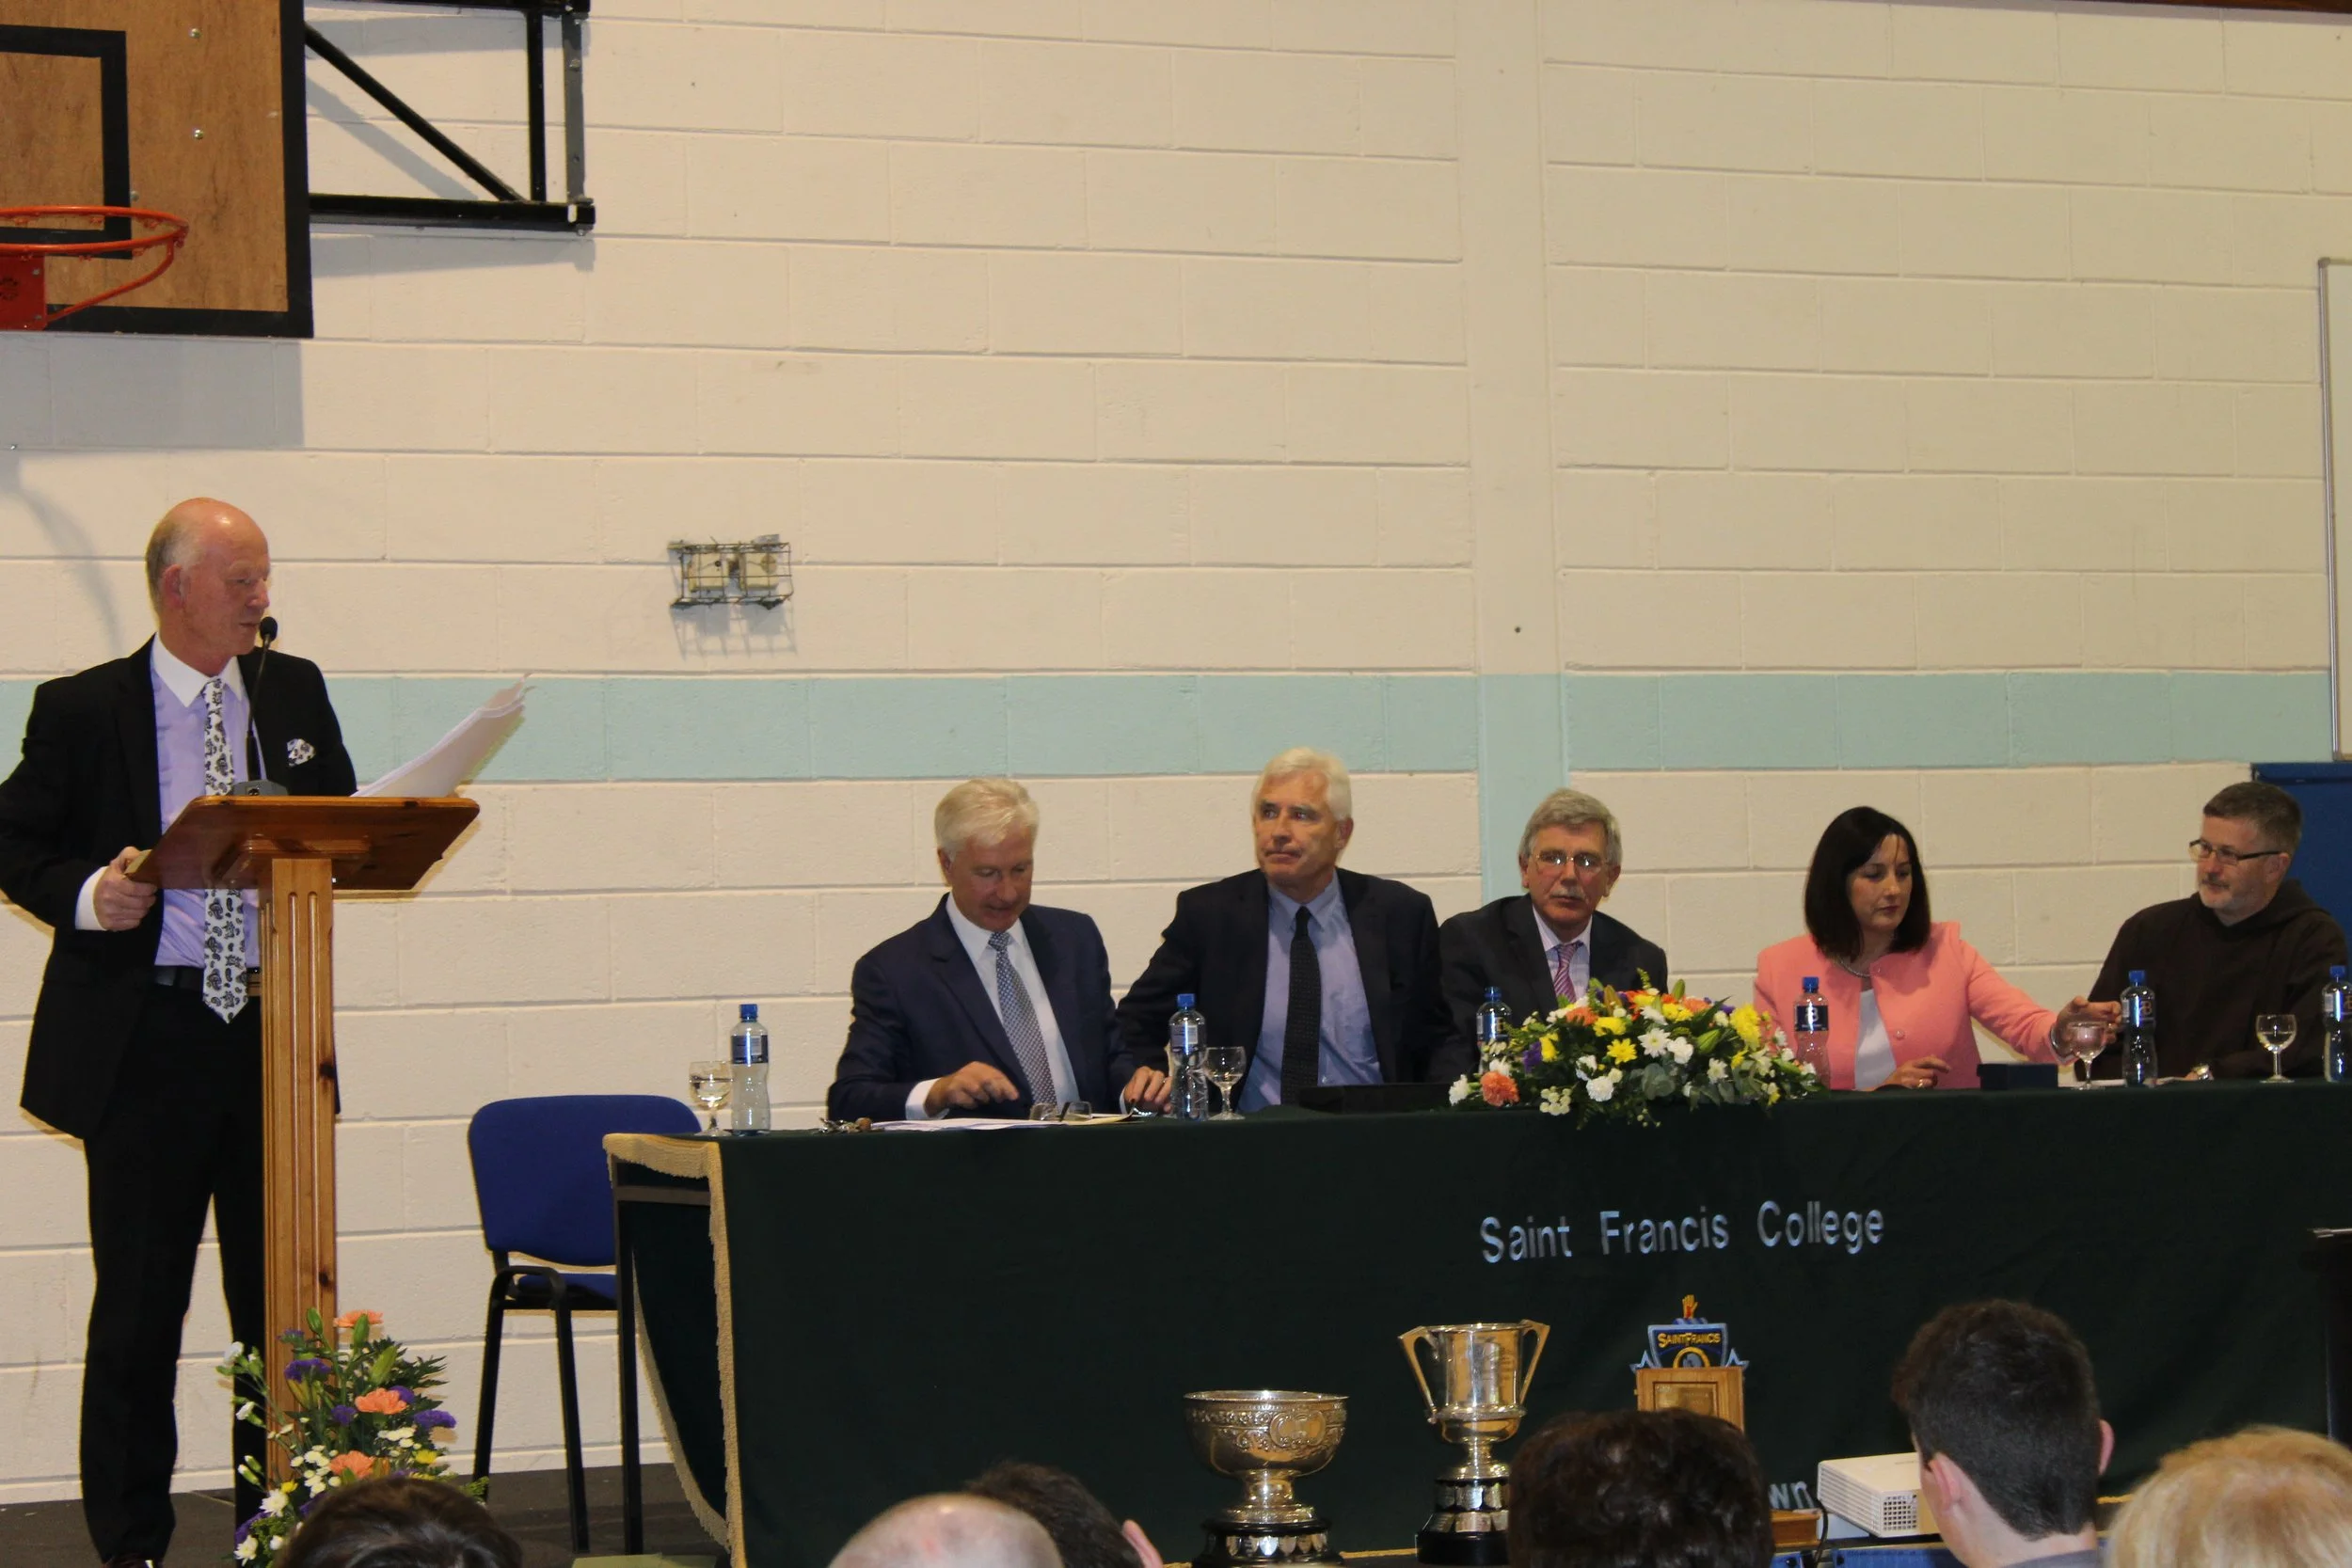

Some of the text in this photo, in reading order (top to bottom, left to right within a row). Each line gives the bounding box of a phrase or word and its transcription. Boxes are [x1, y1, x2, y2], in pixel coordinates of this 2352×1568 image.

[1480, 1199, 1883, 1264] Saint Francis College
